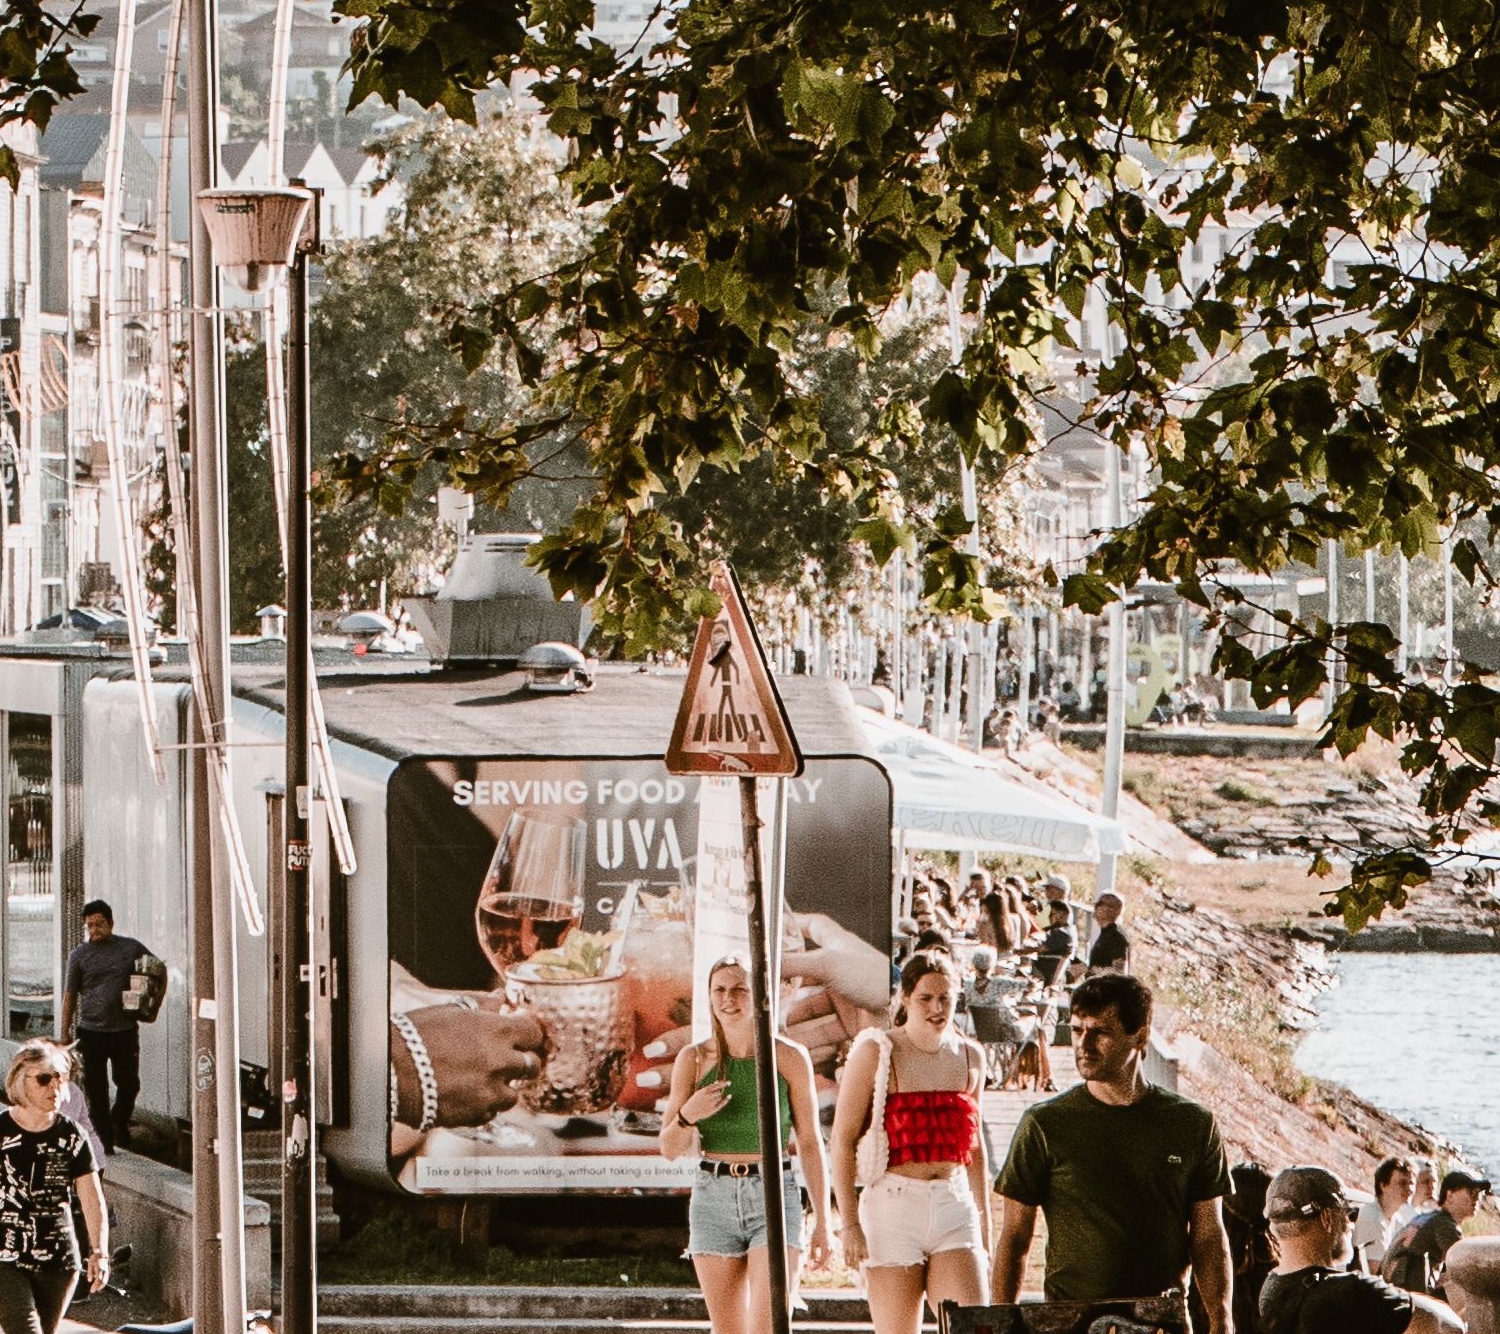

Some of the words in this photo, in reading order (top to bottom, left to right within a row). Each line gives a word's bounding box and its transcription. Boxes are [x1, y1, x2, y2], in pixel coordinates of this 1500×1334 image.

[453, 779, 588, 805] SERVING
[598, 779, 684, 805] FOOD
[596, 818, 682, 870] UVA
[426, 1166, 450, 1177] Take
[453, 1168, 460, 1176] a
[463, 1166, 492, 1177] break
[496, 1166, 520, 1176] from
[568, 1166, 606, 1176] without
[610, 1166, 640, 1178] taking
[654, 1166, 684, 1175] break
